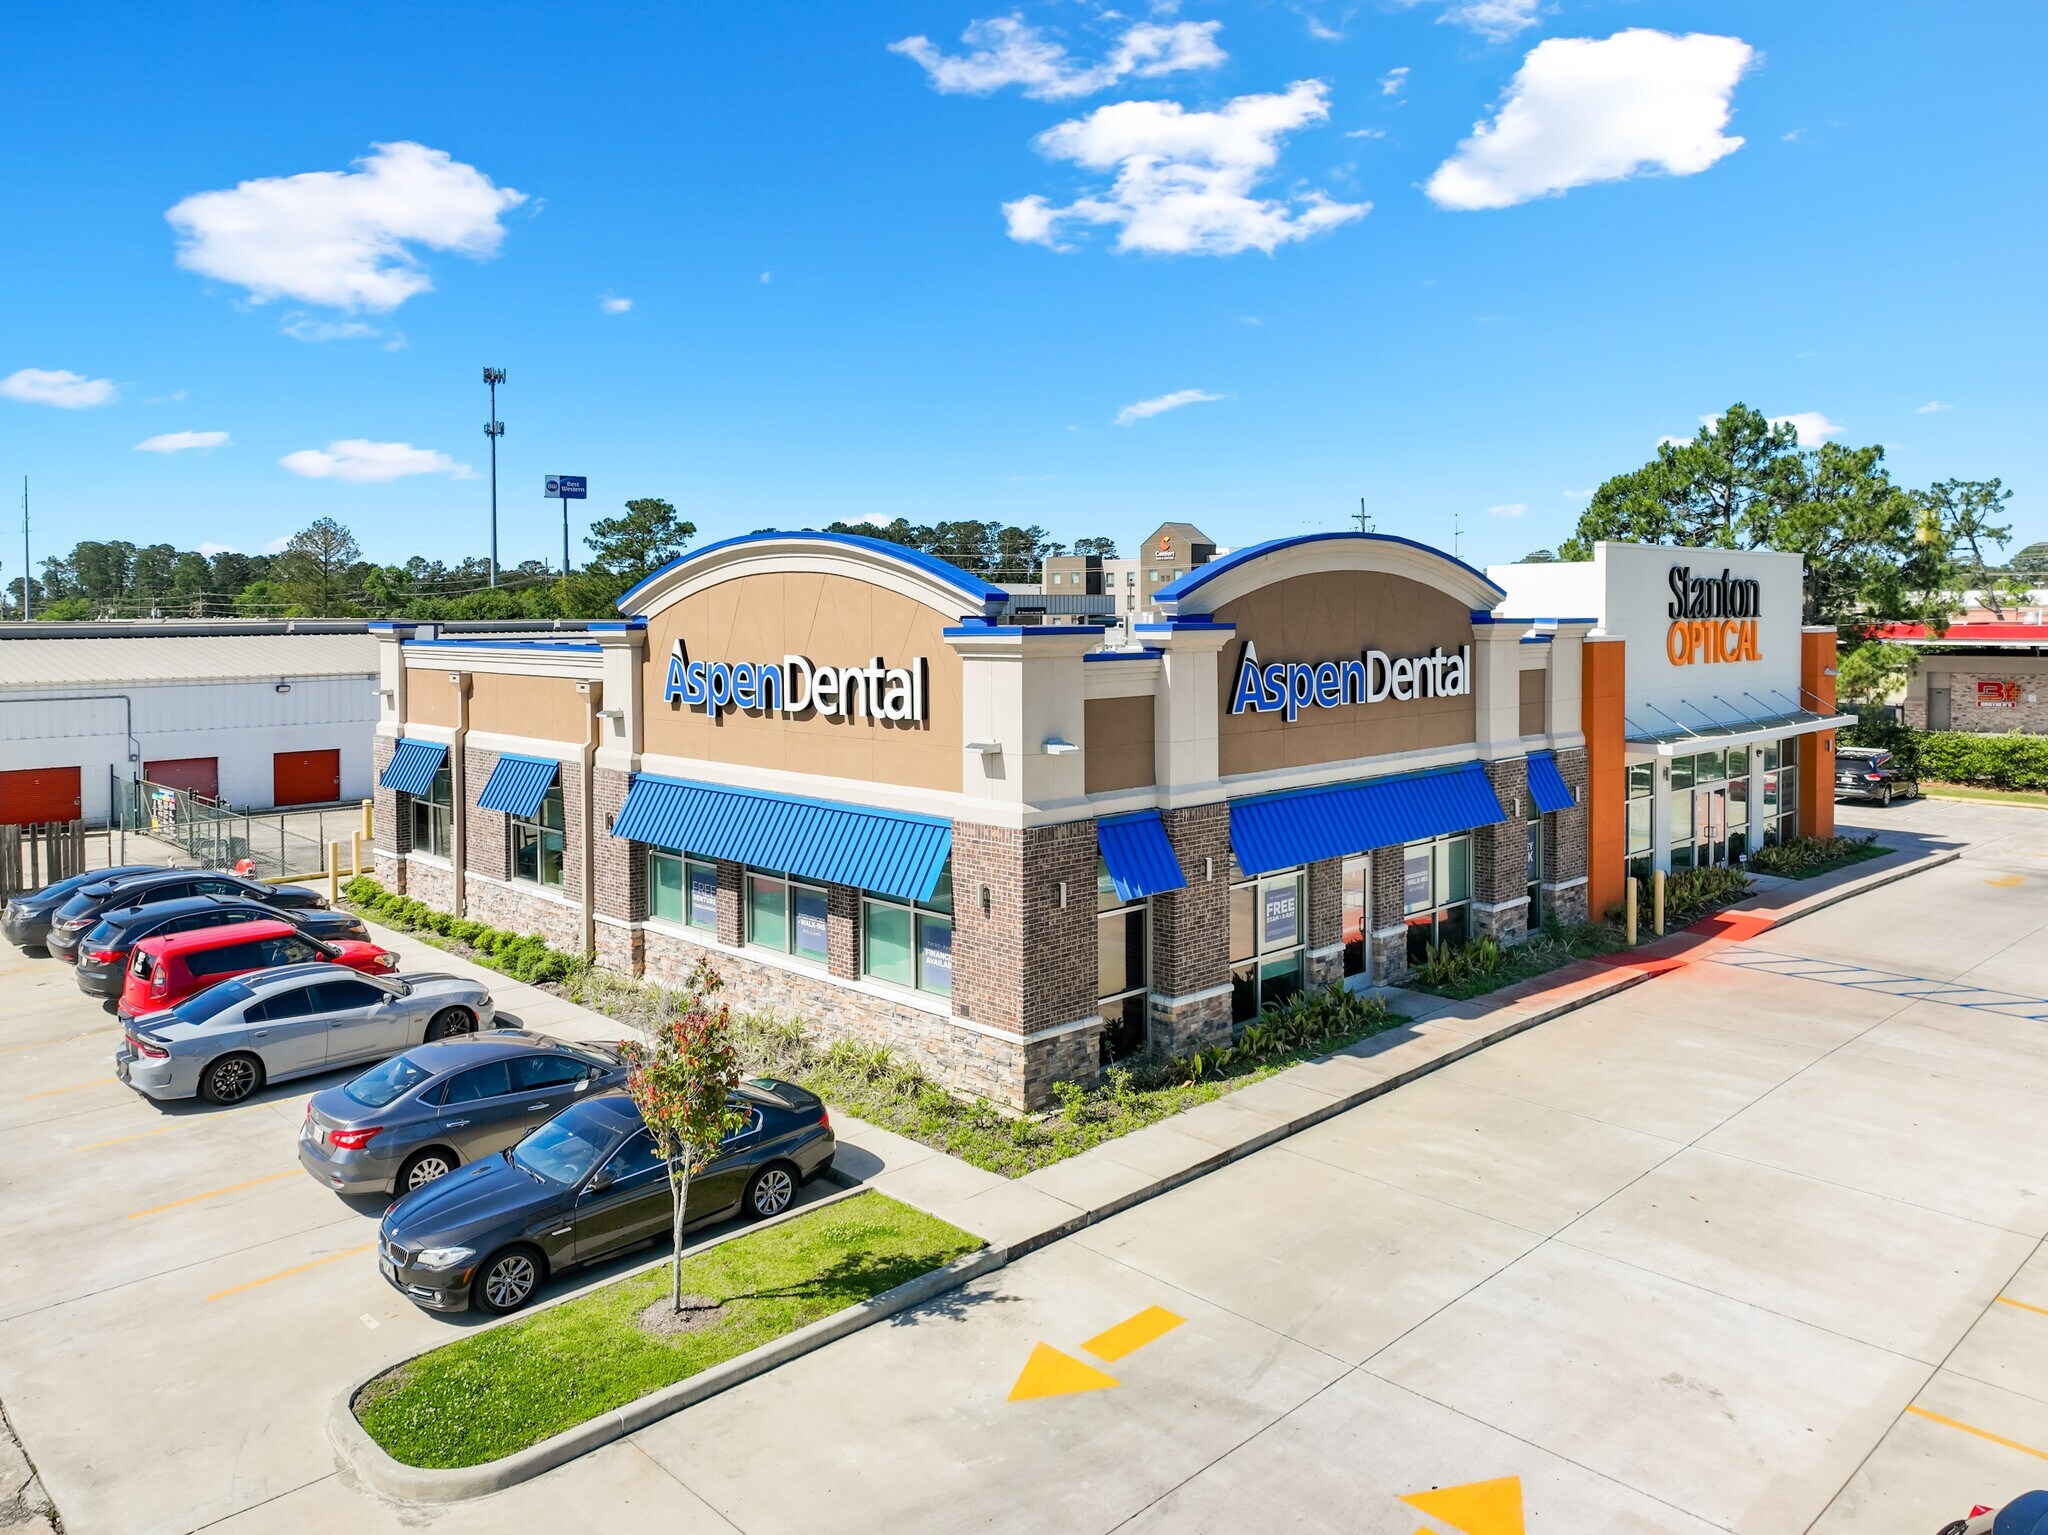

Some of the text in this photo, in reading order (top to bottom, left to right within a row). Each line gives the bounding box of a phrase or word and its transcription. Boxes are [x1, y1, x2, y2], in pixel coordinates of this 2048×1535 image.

[1668, 565, 1762, 620] Stanton
[1667, 620, 1763, 666] OPTICAL
[663, 638, 929, 721] AspenDental
[1229, 640, 1472, 723] AspenDental
[692, 881, 716, 898] FREE
[1266, 897, 1296, 918] FREE
[799, 918, 826, 931] WALK-INS
